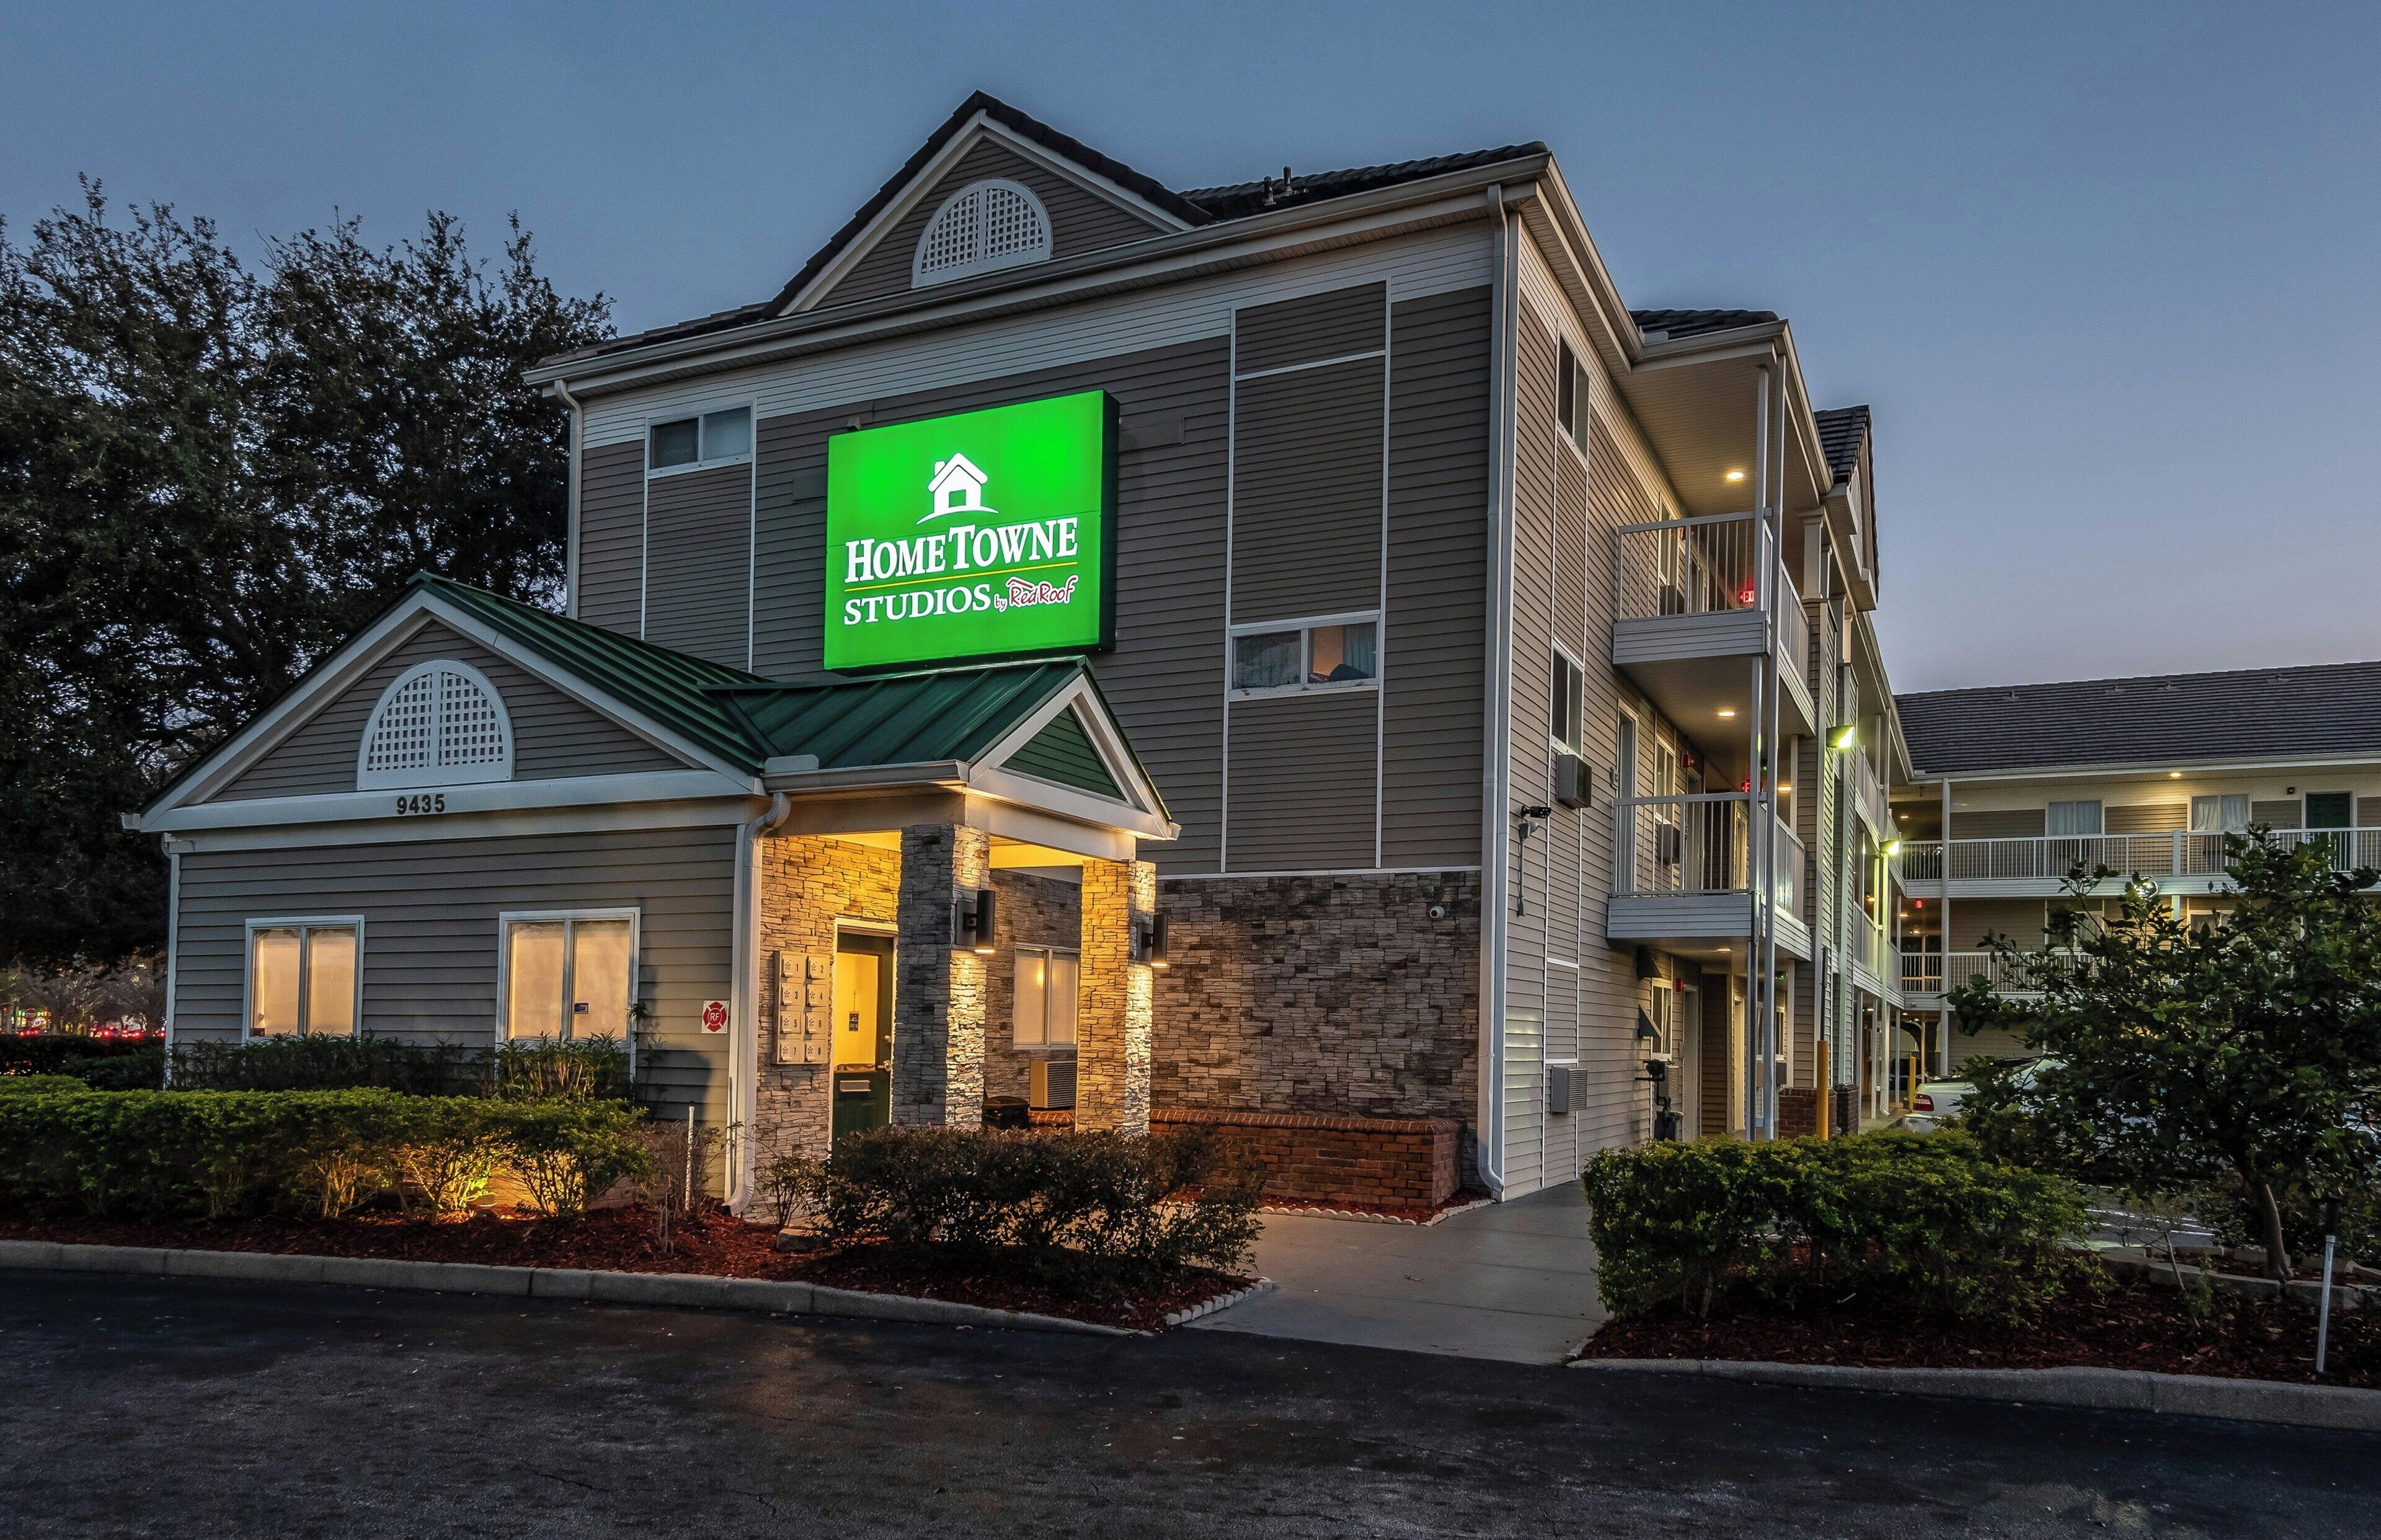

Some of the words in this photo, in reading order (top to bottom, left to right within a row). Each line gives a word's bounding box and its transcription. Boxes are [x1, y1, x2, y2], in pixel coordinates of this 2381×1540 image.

[844, 516, 1078, 583] HOMETOWNE
[844, 583, 991, 625] STUDIOS
[995, 595, 1006, 611] by
[397, 793, 446, 815] 9435
[796, 963, 799, 971] 1
[820, 965, 824, 973] 2
[794, 991, 799, 999] 3
[820, 992, 823, 1000] 4
[710, 1012, 720, 1021] RF
[794, 1019, 797, 1027] 5
[818, 1020, 822, 1028] 6
[794, 1047, 797, 1055] 7
[818, 1047, 822, 1055] 8
